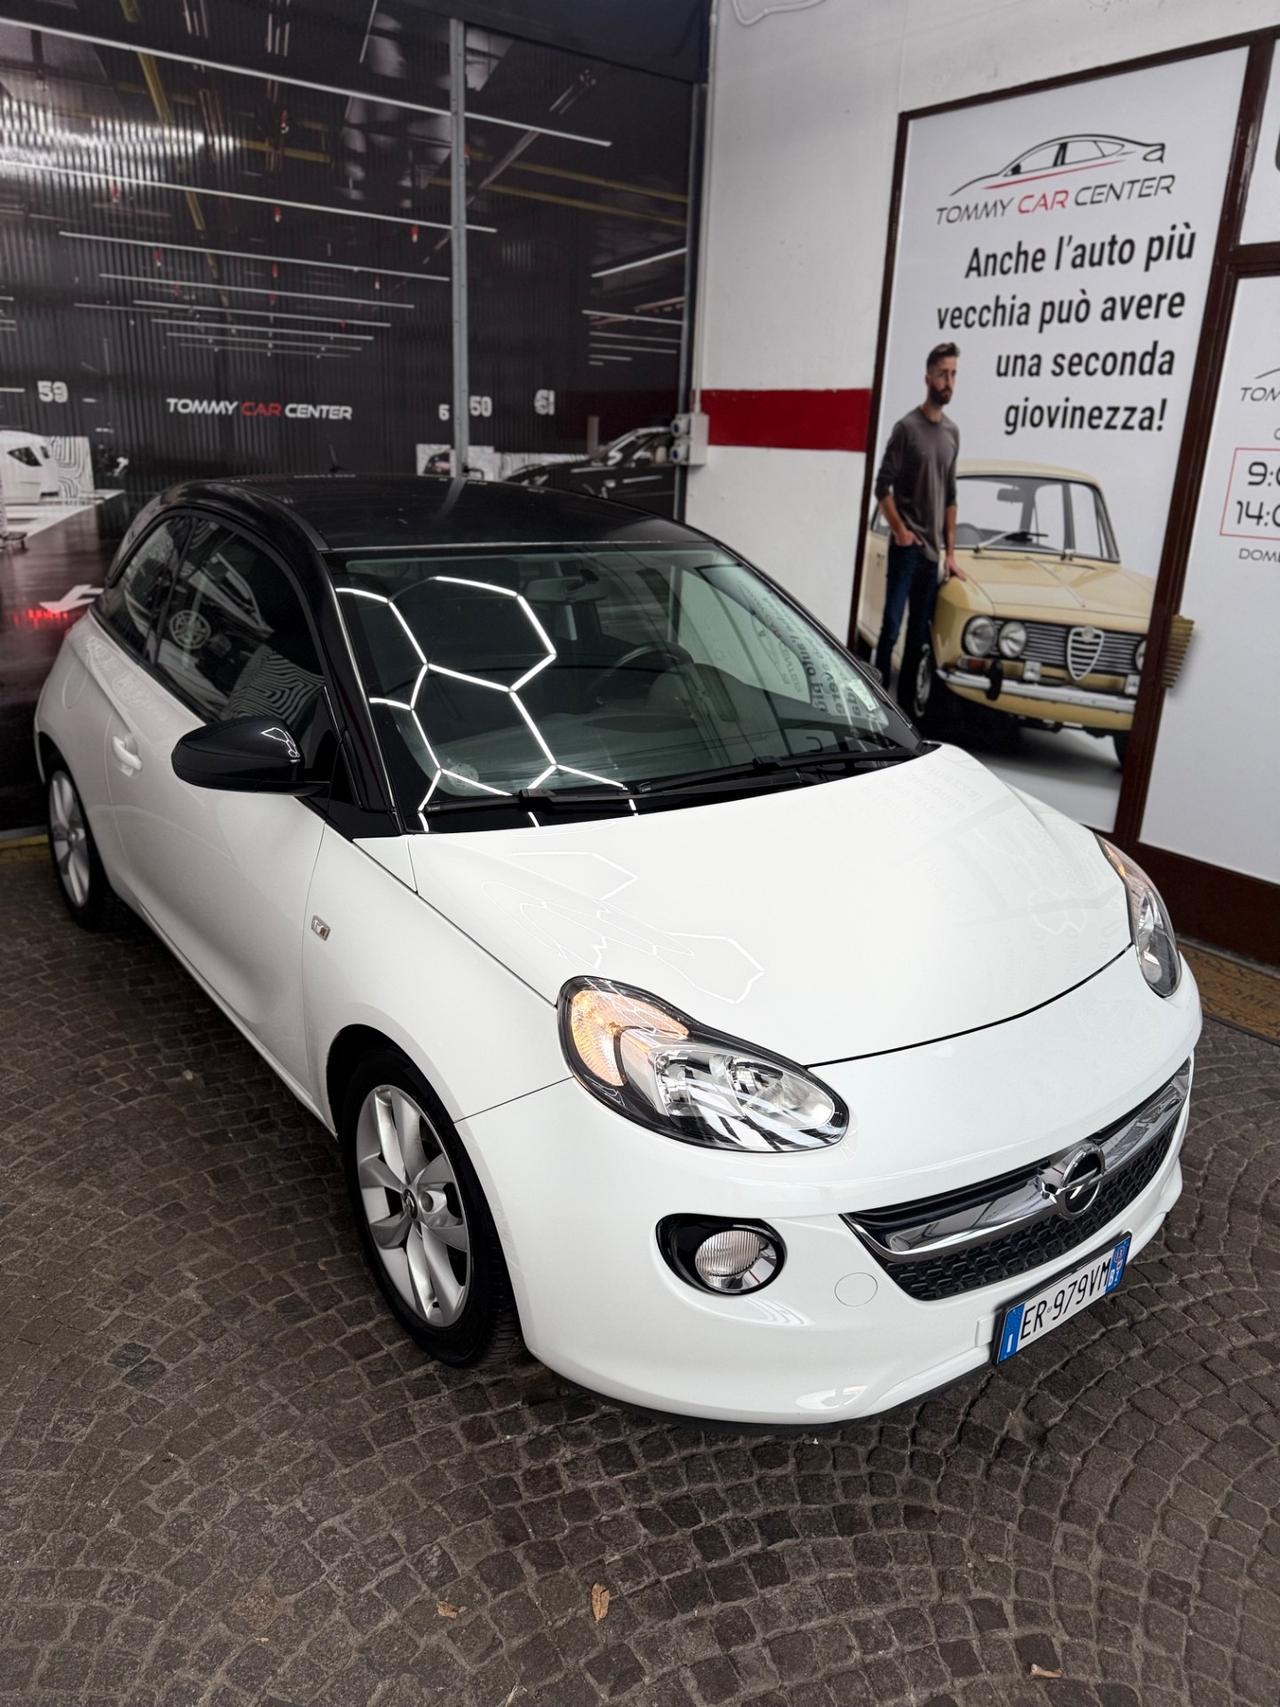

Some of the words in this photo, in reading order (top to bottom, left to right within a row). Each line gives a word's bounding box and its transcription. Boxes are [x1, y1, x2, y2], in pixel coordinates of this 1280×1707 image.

[936, 197, 1014, 225] TOMMY
[1018, 189, 1069, 214] CAR
[1075, 174, 1175, 207] CENTER
[965, 241, 1046, 279] Anche
[1055, 234, 1136, 272] l'auto
[1144, 222, 1197, 272] più
[937, 294, 1031, 330] vecchia
[1038, 288, 1091, 334] può
[1100, 291, 1186, 322] avere
[996, 353, 1042, 377] una
[1051, 340, 1175, 377] seconda
[166, 398, 239, 415] TOMMY
[240, 401, 283, 417] CAR
[285, 403, 353, 420] CENTER
[1004, 396, 1168, 435] giovinezza!
[1248, 462, 1280, 488] 9:
[1239, 548, 1280, 563] DOM
